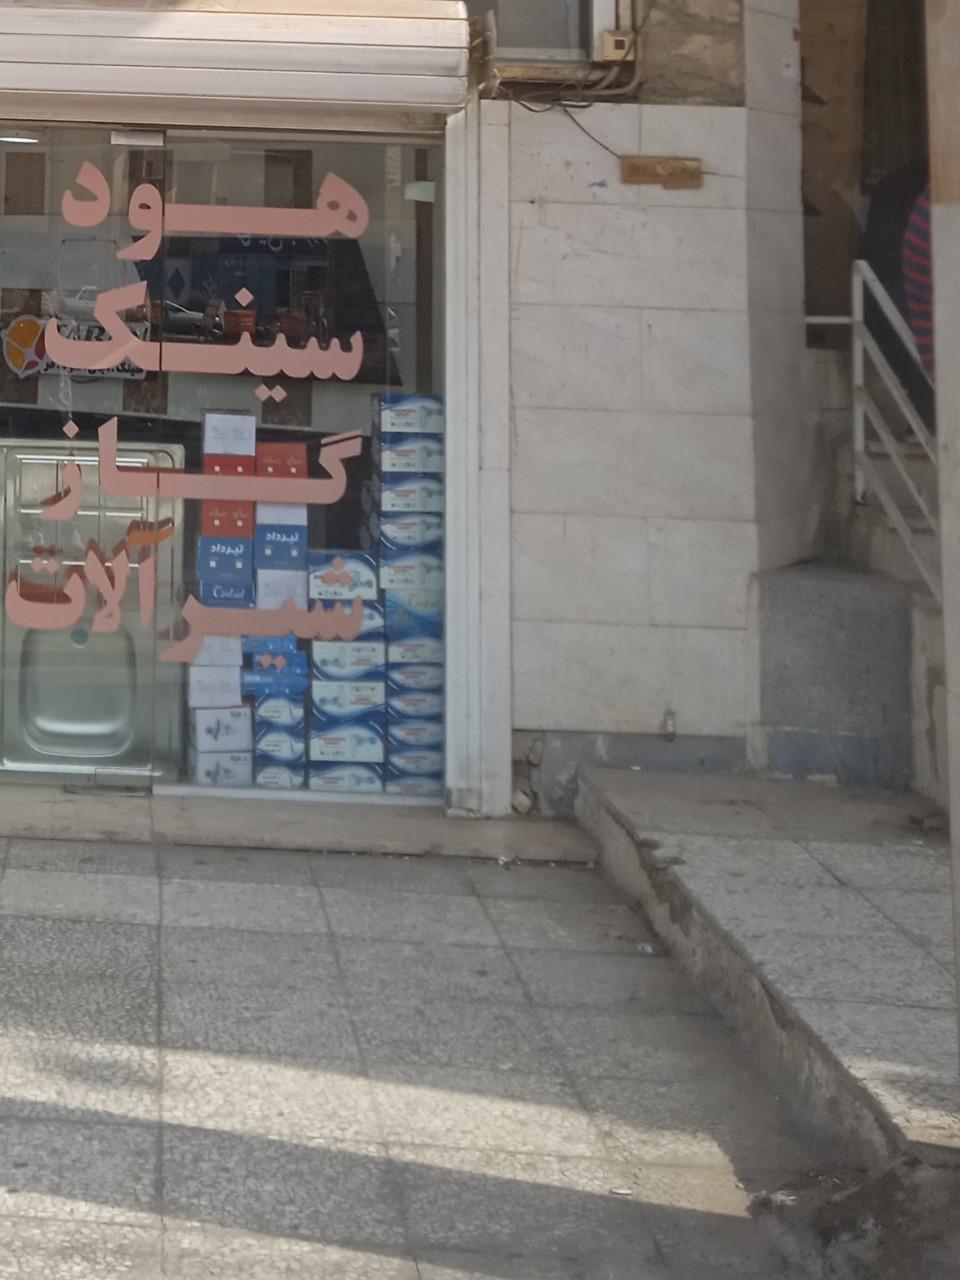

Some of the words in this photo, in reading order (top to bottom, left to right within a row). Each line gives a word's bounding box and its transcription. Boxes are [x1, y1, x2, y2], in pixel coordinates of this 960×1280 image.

[61, 160, 370, 260] هود
[44, 280, 364, 403] سینک
[39, 416, 363, 520] گاز
